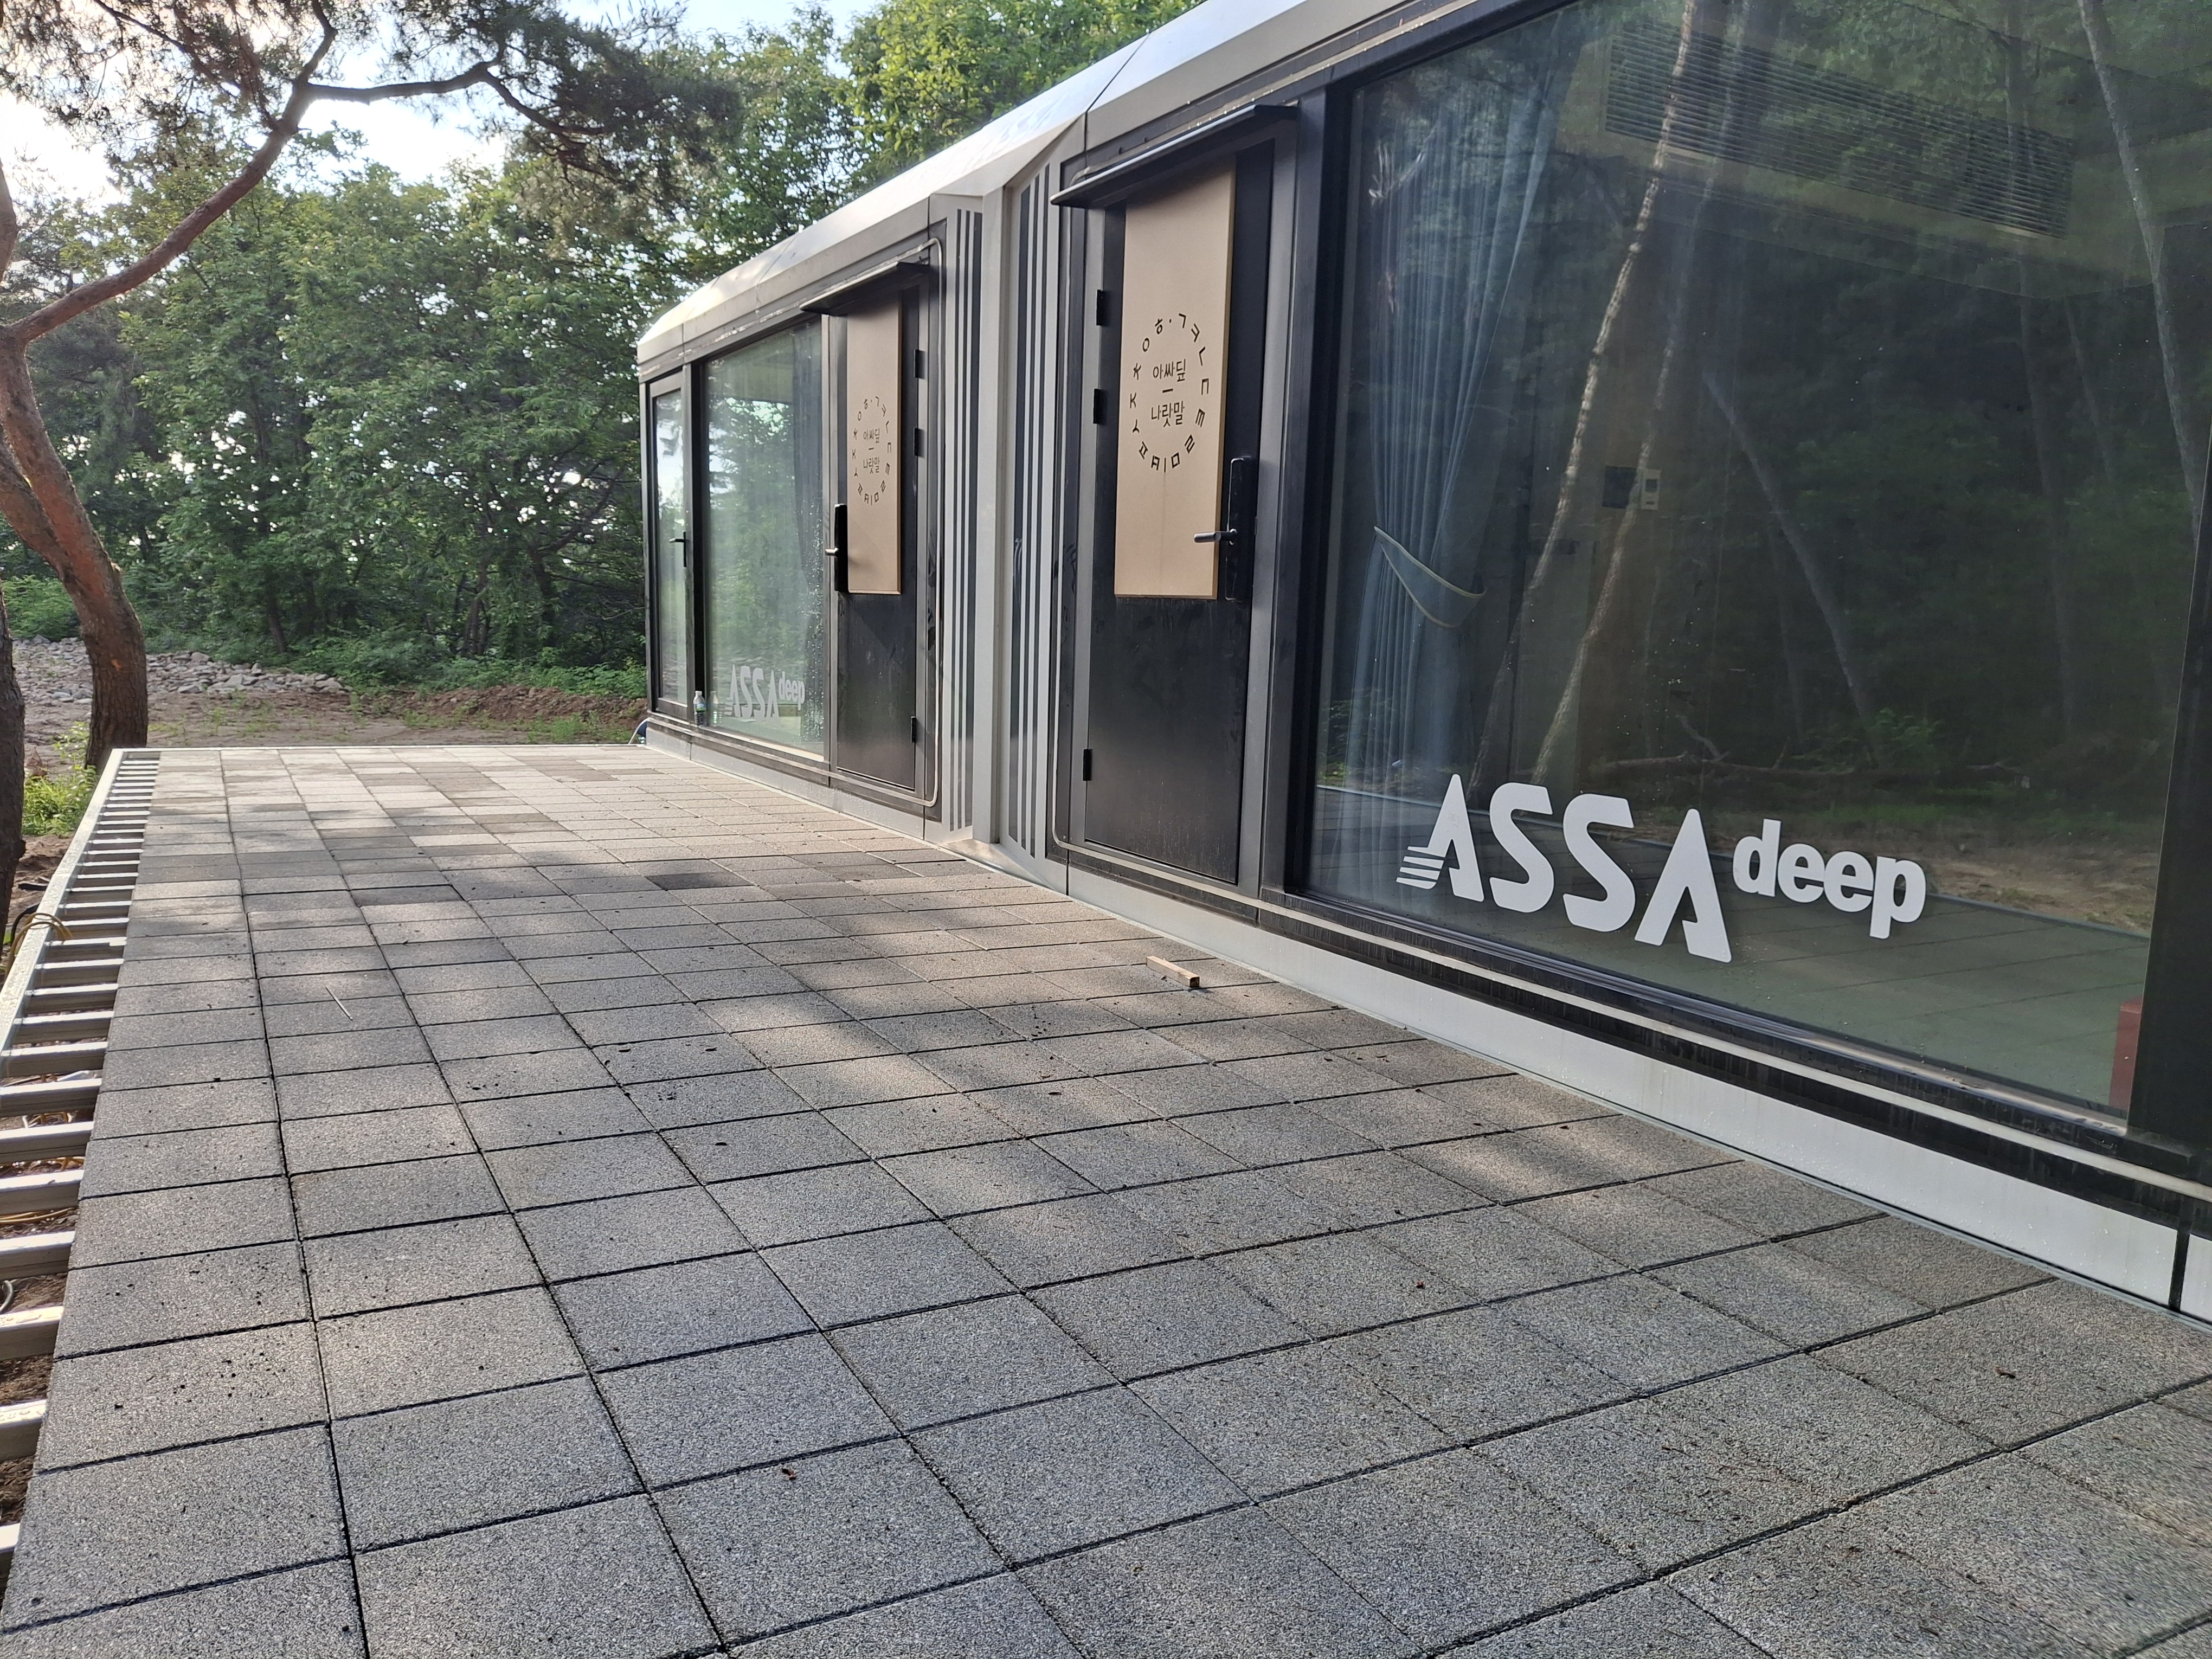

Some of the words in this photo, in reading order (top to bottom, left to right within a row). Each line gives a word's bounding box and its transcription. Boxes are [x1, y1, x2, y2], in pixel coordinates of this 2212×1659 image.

[1150, 400, 1186, 428] 나랏말
[724, 664, 780, 724] ASSA
[779, 671, 806, 711] deep
[1396, 774, 1732, 963] ASSA
[1733, 818, 1926, 939] deep
